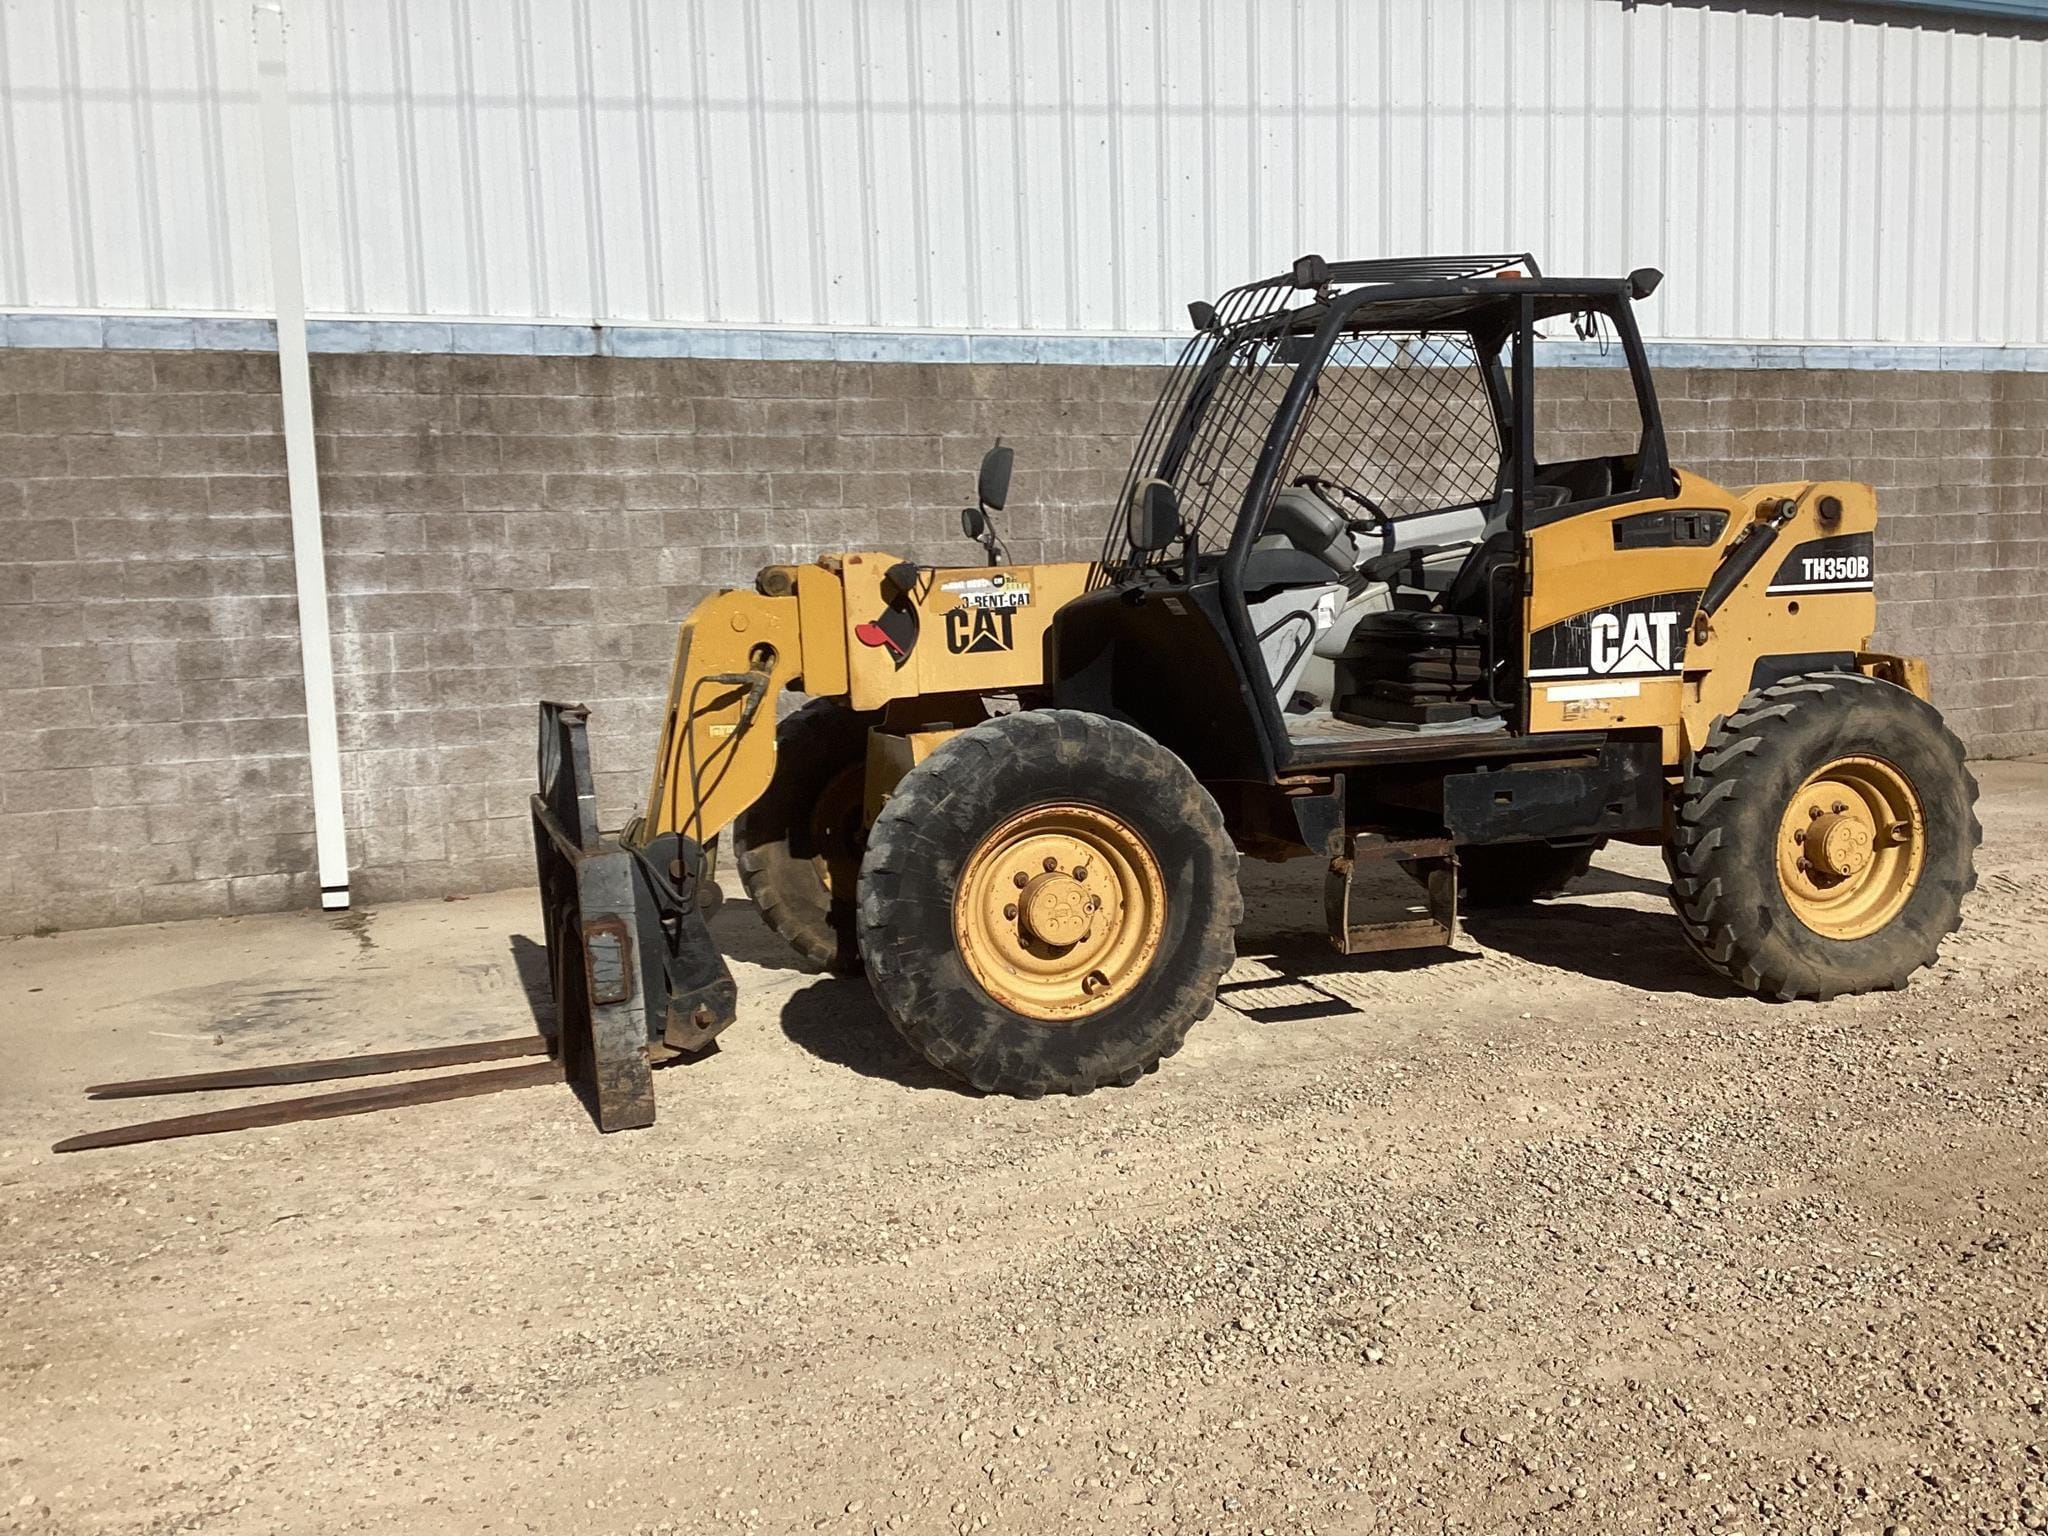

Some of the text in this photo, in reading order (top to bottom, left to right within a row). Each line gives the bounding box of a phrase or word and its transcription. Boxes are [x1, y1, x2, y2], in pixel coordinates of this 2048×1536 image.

[1802, 556, 1869, 580] TH350B
[945, 606, 1017, 654] CAT
[1591, 611, 1677, 674] CAT
